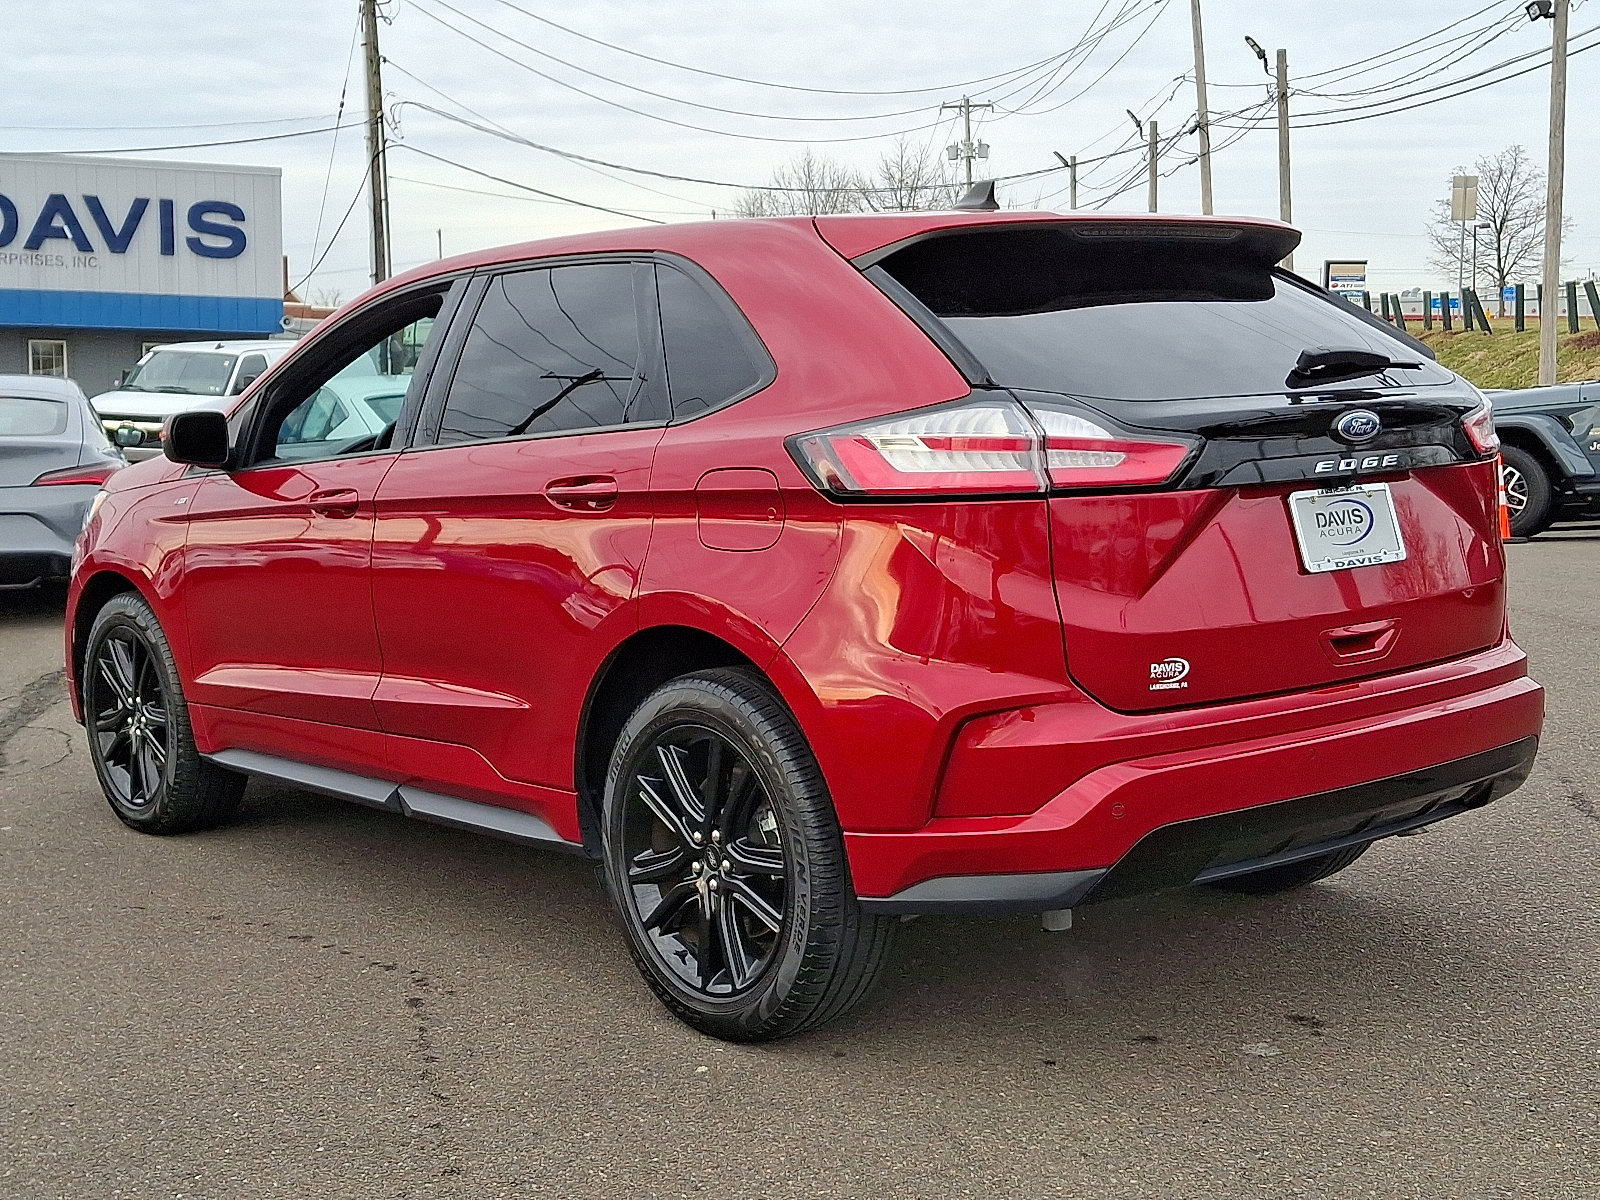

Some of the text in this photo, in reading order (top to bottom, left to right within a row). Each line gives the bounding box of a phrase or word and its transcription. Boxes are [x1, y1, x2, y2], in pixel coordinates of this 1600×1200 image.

[1350, 418, 1373, 434] Ford
[1314, 454, 1399, 473] EDGE
[1315, 508, 1363, 528] DAVIS
[1319, 526, 1362, 538] ACURA
[1335, 555, 1382, 568] DAVIS
[1150, 662, 1182, 672] DAVIS
